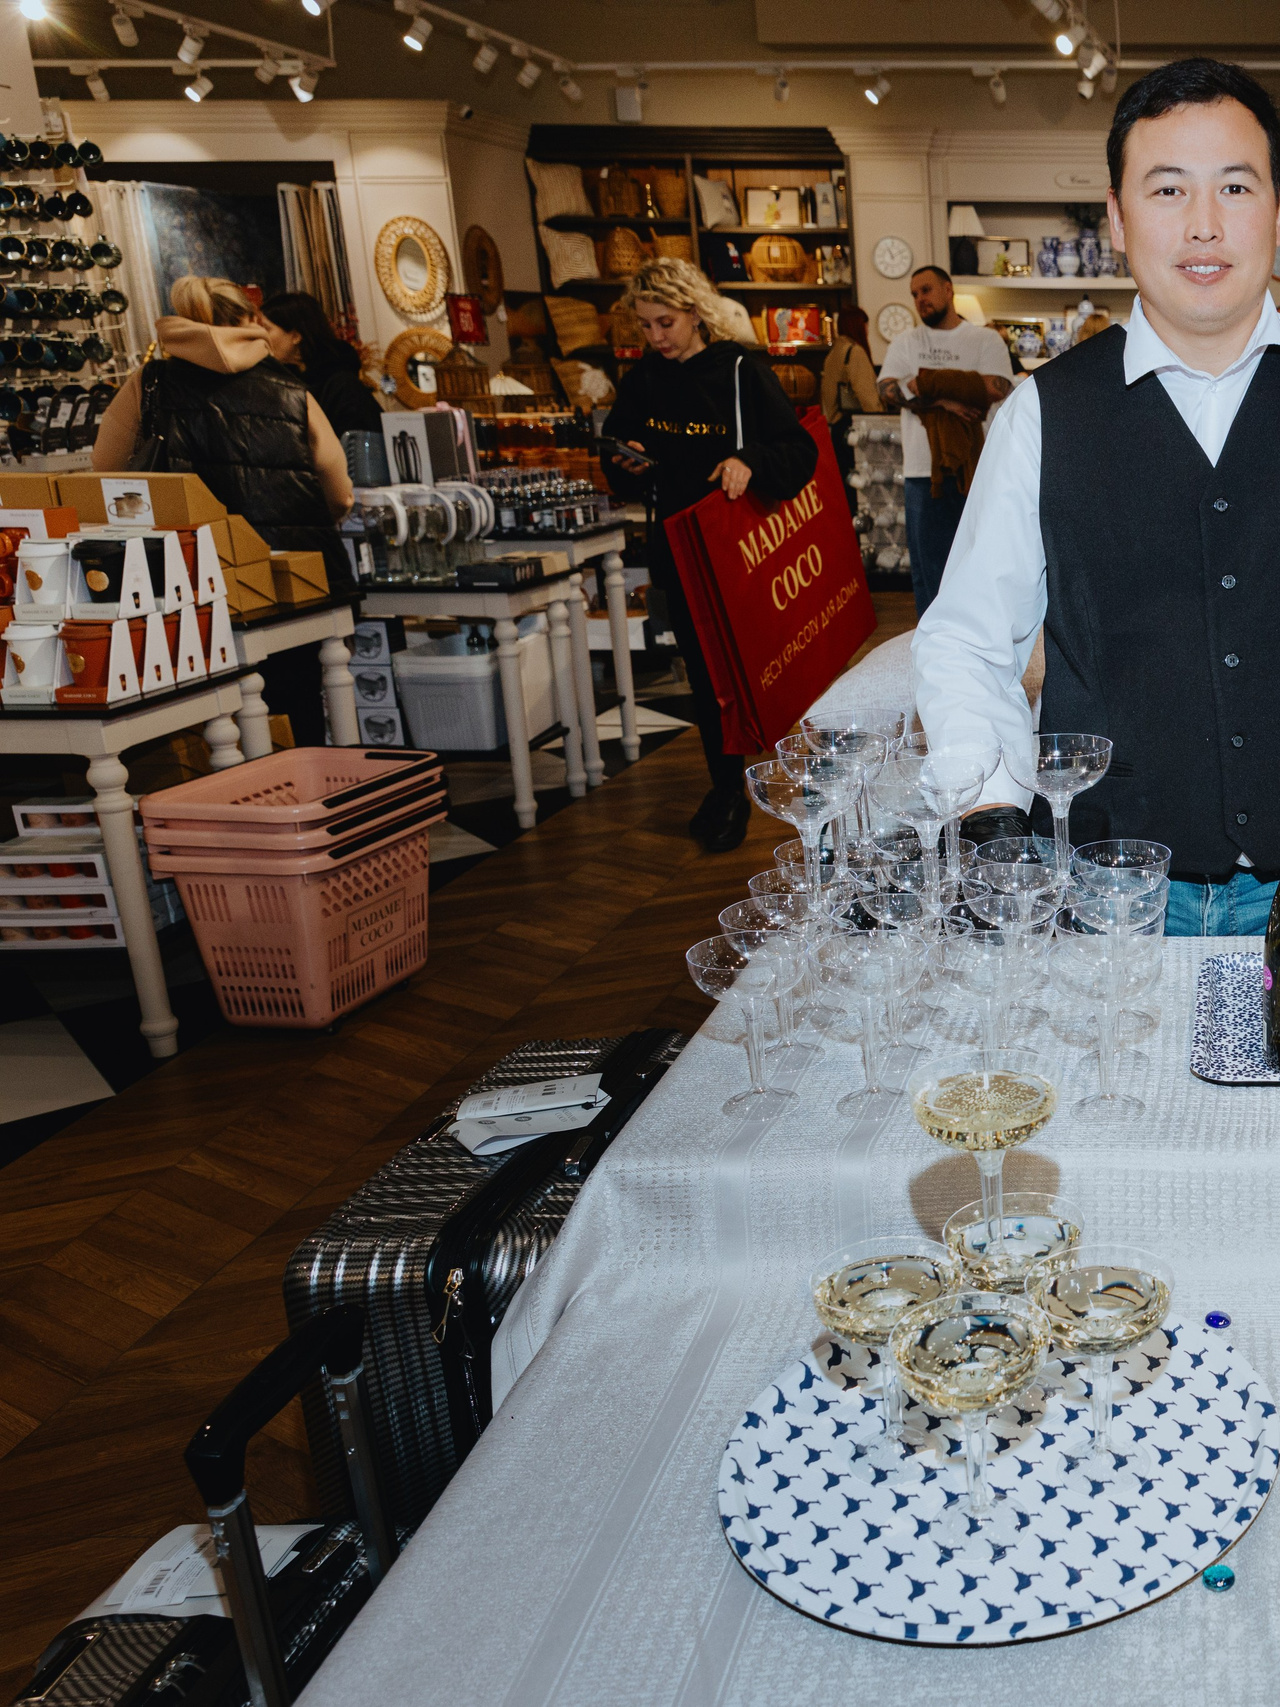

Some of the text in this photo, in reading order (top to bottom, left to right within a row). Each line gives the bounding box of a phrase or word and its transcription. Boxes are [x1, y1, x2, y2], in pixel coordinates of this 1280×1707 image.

[738, 480, 823, 574] MADAME
[771, 543, 823, 611] COCO
[760, 577, 860, 691] НЕСУ КРАСОТУ ДЛЯ ДОМА
[352, 899, 401, 935] MADAME
[360, 920, 393, 946] COCO
